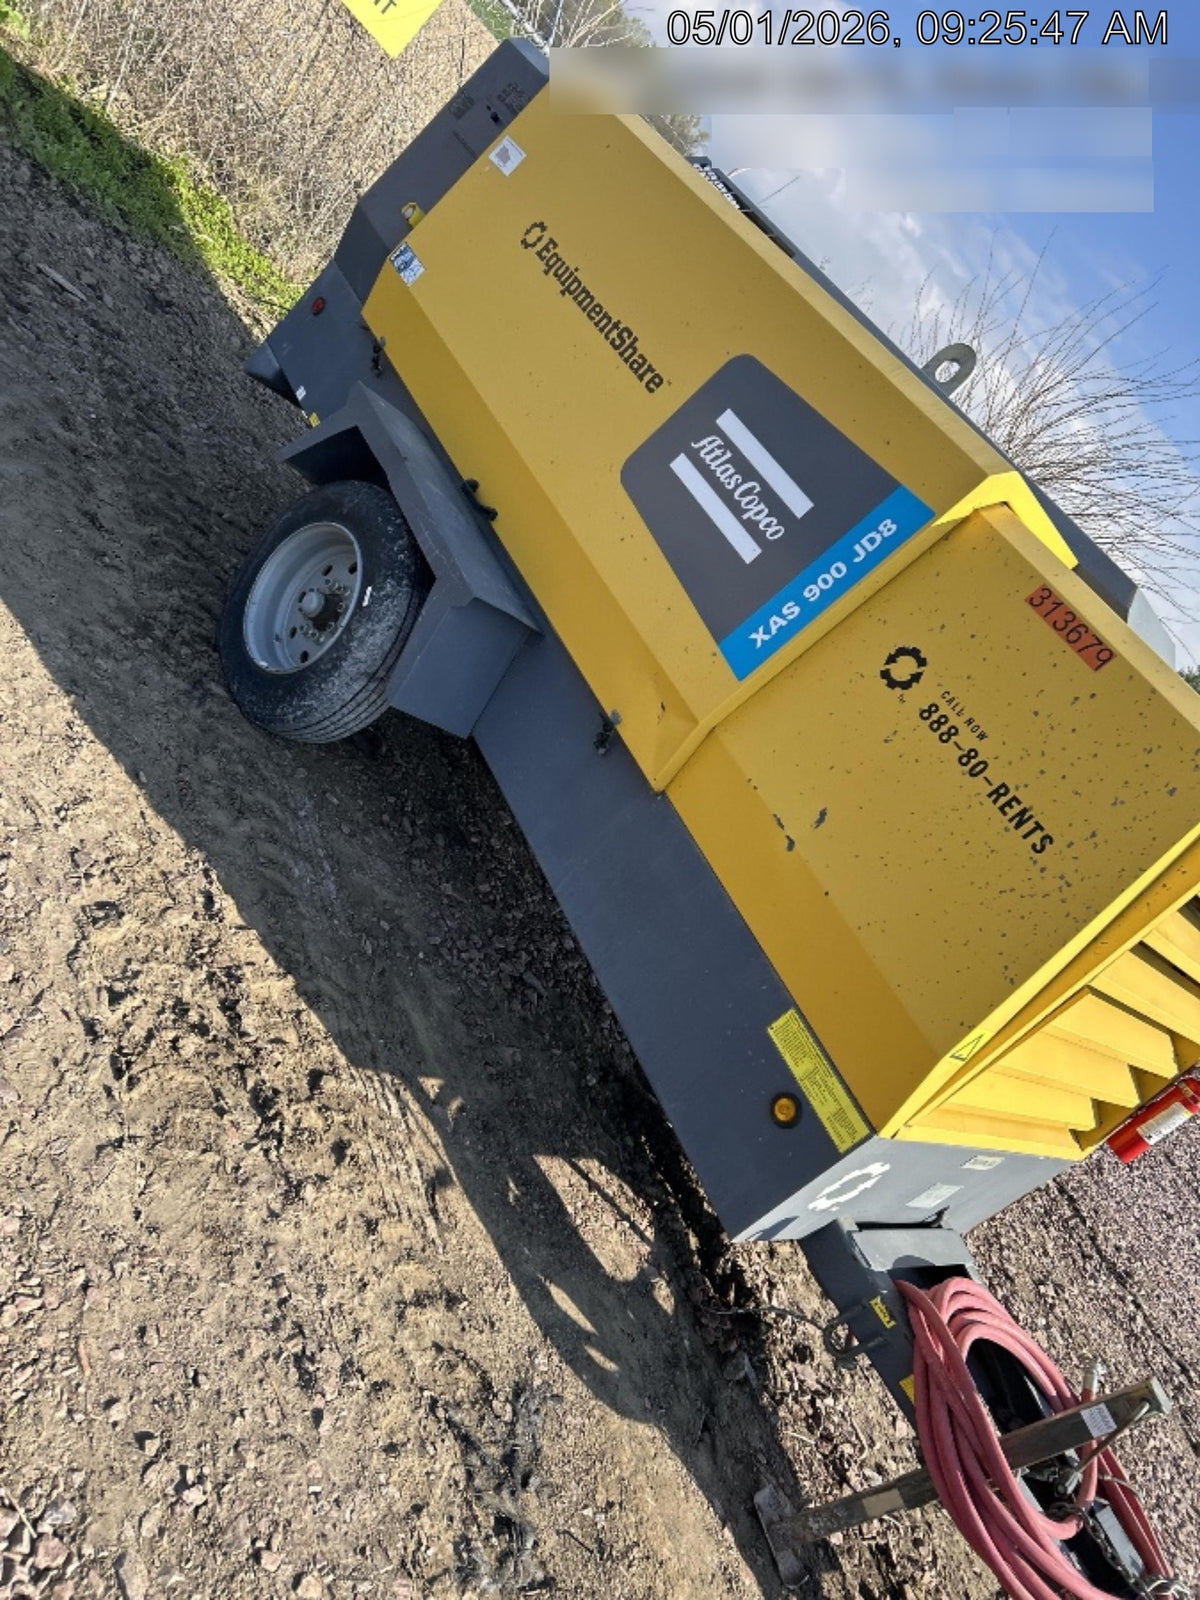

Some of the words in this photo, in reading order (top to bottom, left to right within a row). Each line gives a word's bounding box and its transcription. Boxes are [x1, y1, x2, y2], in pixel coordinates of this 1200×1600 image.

[535, 237, 664, 393] EquipmentShare
[748, 601, 801, 648] XAS
[803, 561, 847, 602] 900
[853, 518, 898, 563] JD8
[1028, 587, 1114, 671] 313679
[940, 690, 965, 717] CALL
[918, 703, 1053, 854] 888-80-RENTS
